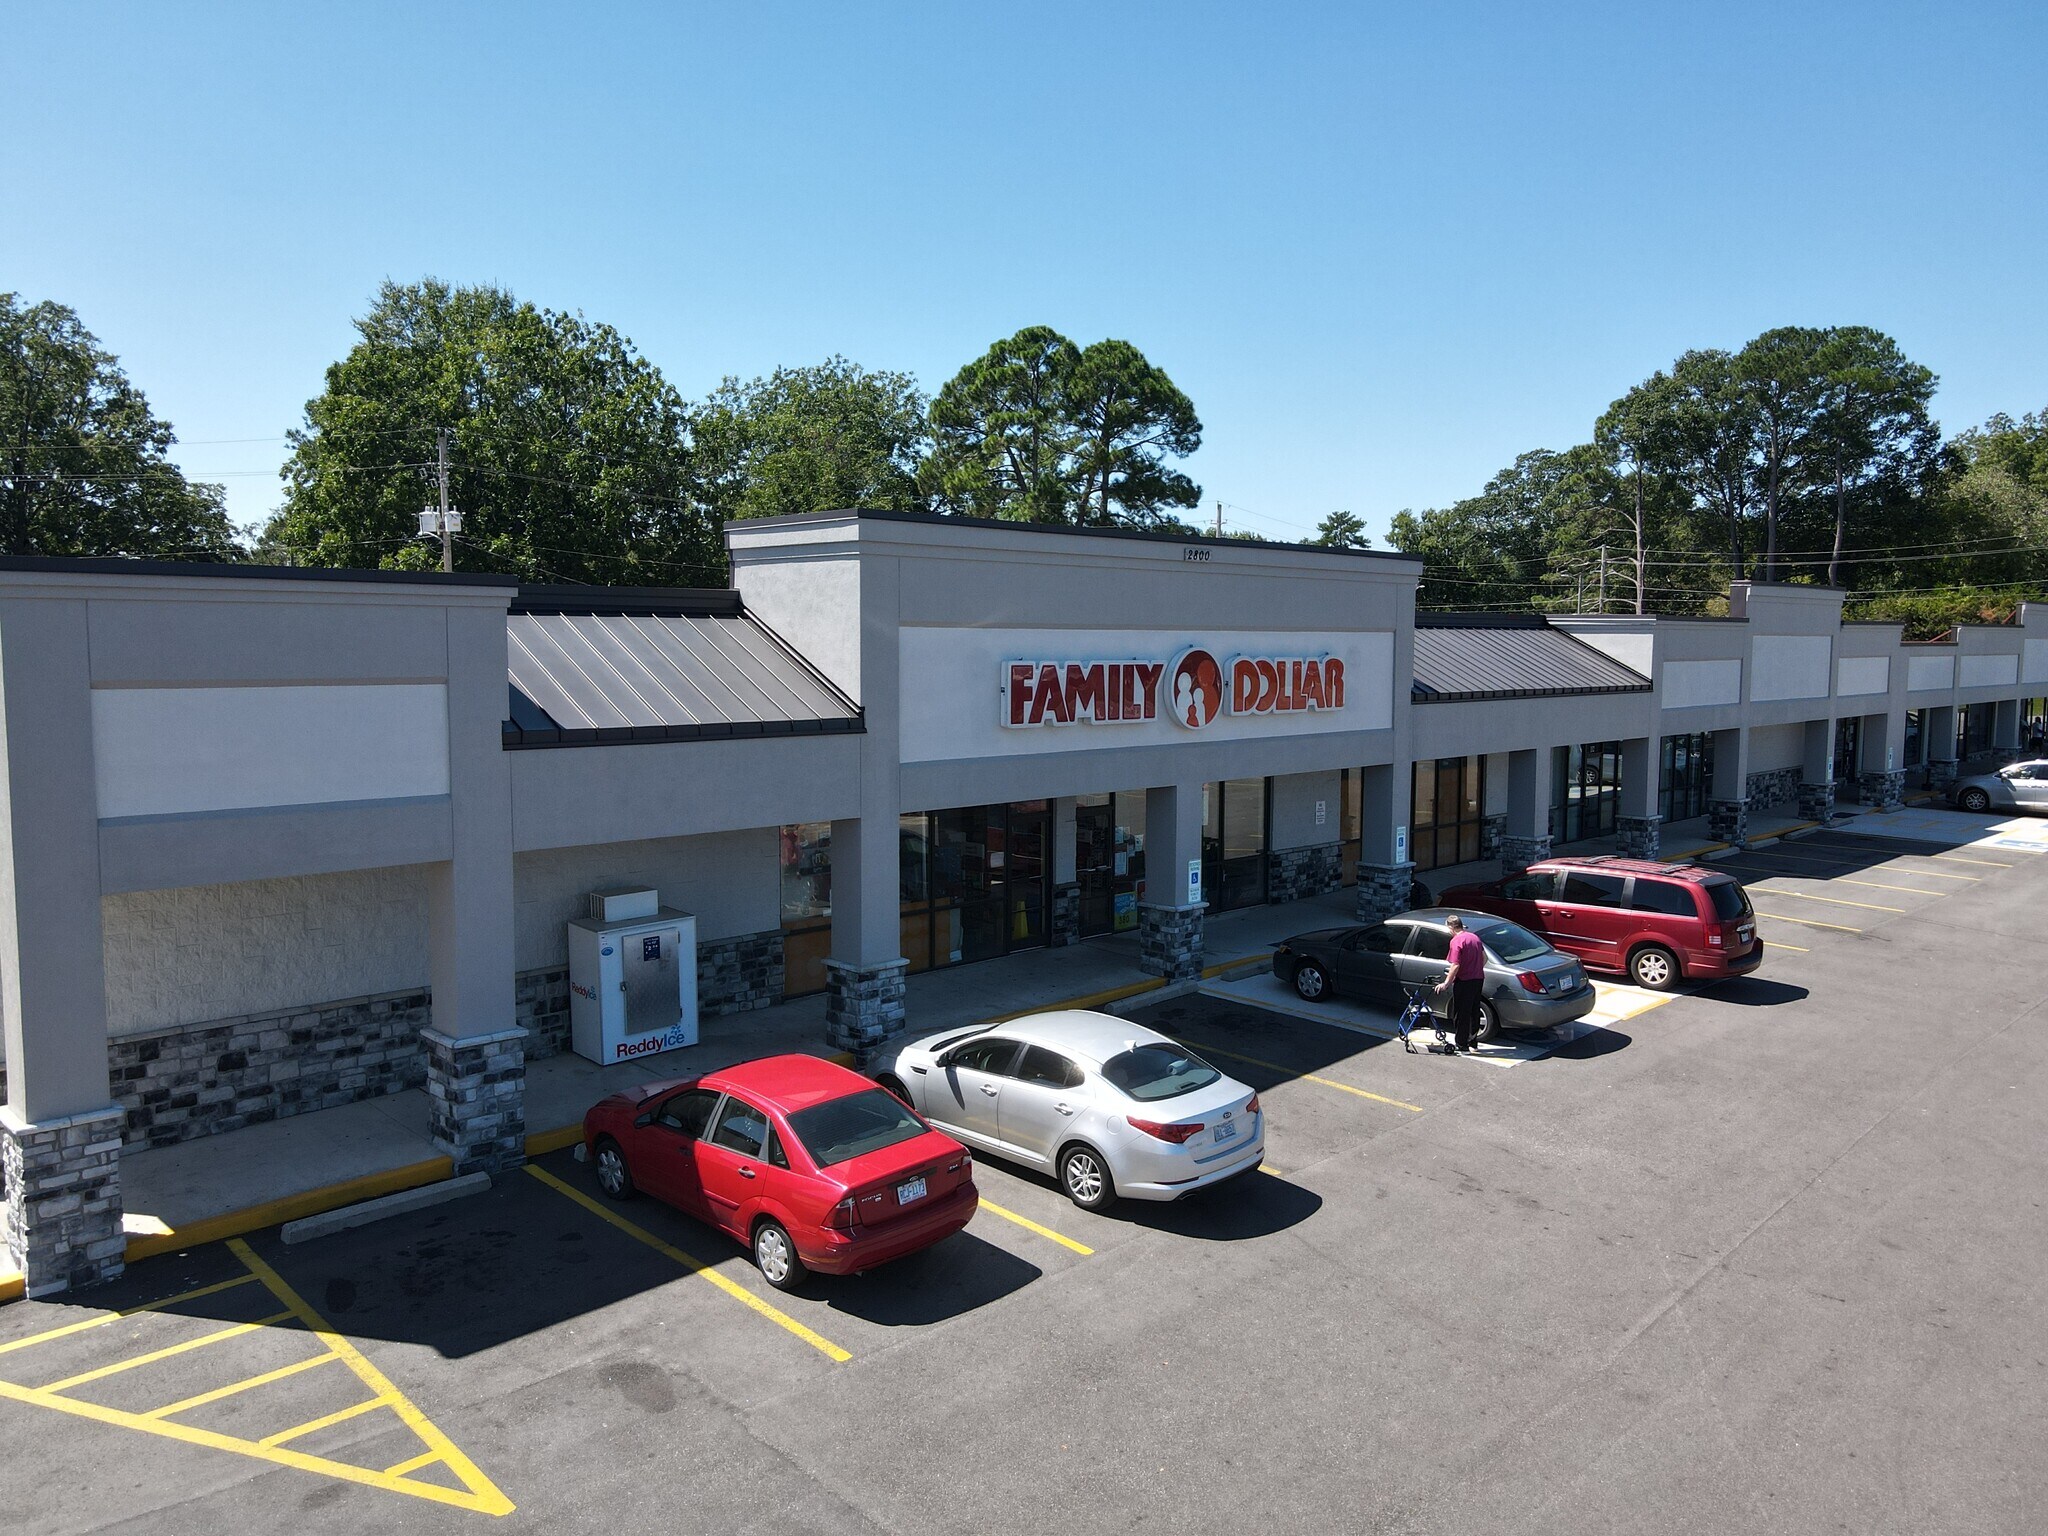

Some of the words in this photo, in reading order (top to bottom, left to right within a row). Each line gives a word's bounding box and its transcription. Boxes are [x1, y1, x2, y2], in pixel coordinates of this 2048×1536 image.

[1188, 549, 1210, 561] 2800
[1010, 663, 1164, 725] FAMILY
[1234, 657, 1345, 713] DOLLAR
[616, 1031, 685, 1058] ReddyIce
